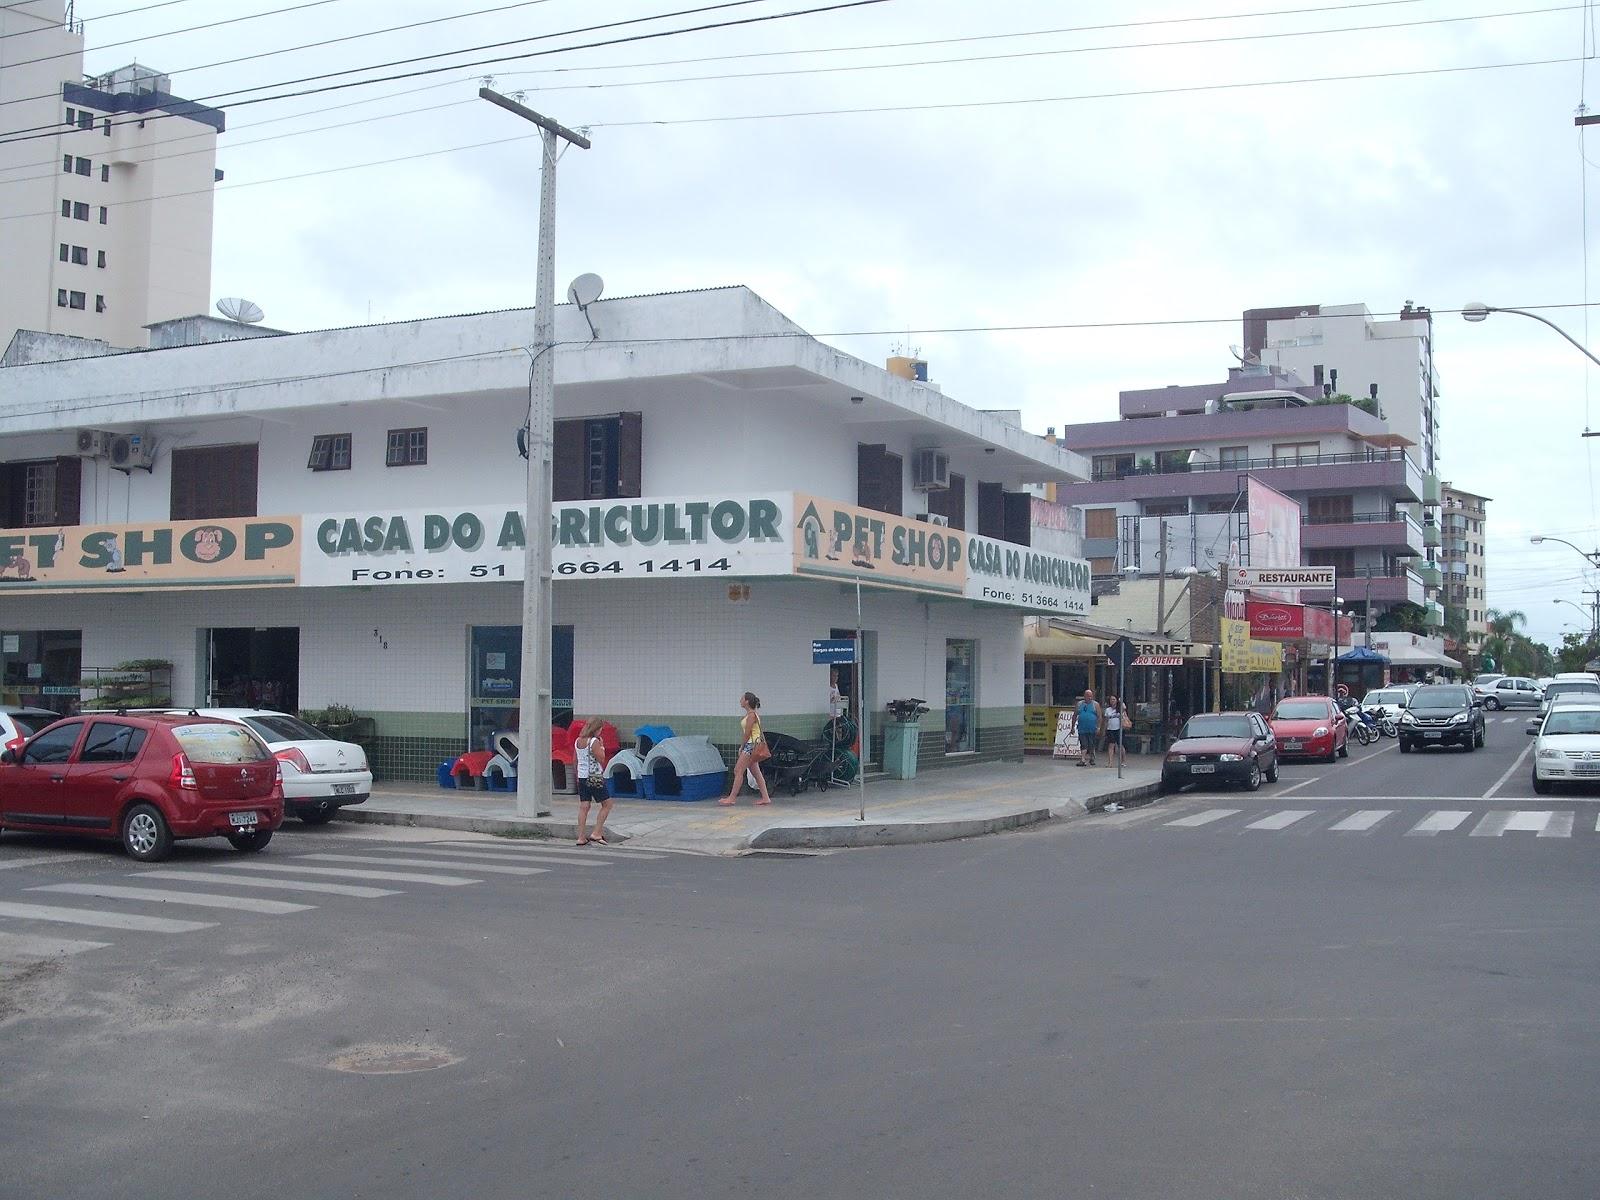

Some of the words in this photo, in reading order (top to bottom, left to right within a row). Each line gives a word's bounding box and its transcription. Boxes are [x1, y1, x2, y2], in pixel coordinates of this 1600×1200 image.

[79, 522, 294, 569] SHOP
[317, 516, 414, 556] CASA
[424, 512, 485, 553] DO
[834, 510, 885, 559] PET
[892, 526, 961, 571] SHOP
[352, 568, 445, 580] Fone:
[470, 565, 505, 577] 51
[551, 561, 623, 575] 664
[639, 558, 732, 573] 1414
[968, 538, 1002, 575] CASA
[1006, 549, 1020, 579] DO
[1024, 552, 1089, 592] AGRICULTOR
[1259, 573, 1332, 582] RESTAURANTE
[983, 587, 1015, 600] Fone:
[1022, 594, 1033, 604] 51
[1036, 595, 1058, 607] 3664
[1064, 600, 1084, 611] 1414
[1151, 656, 1181, 664] QUENTE
